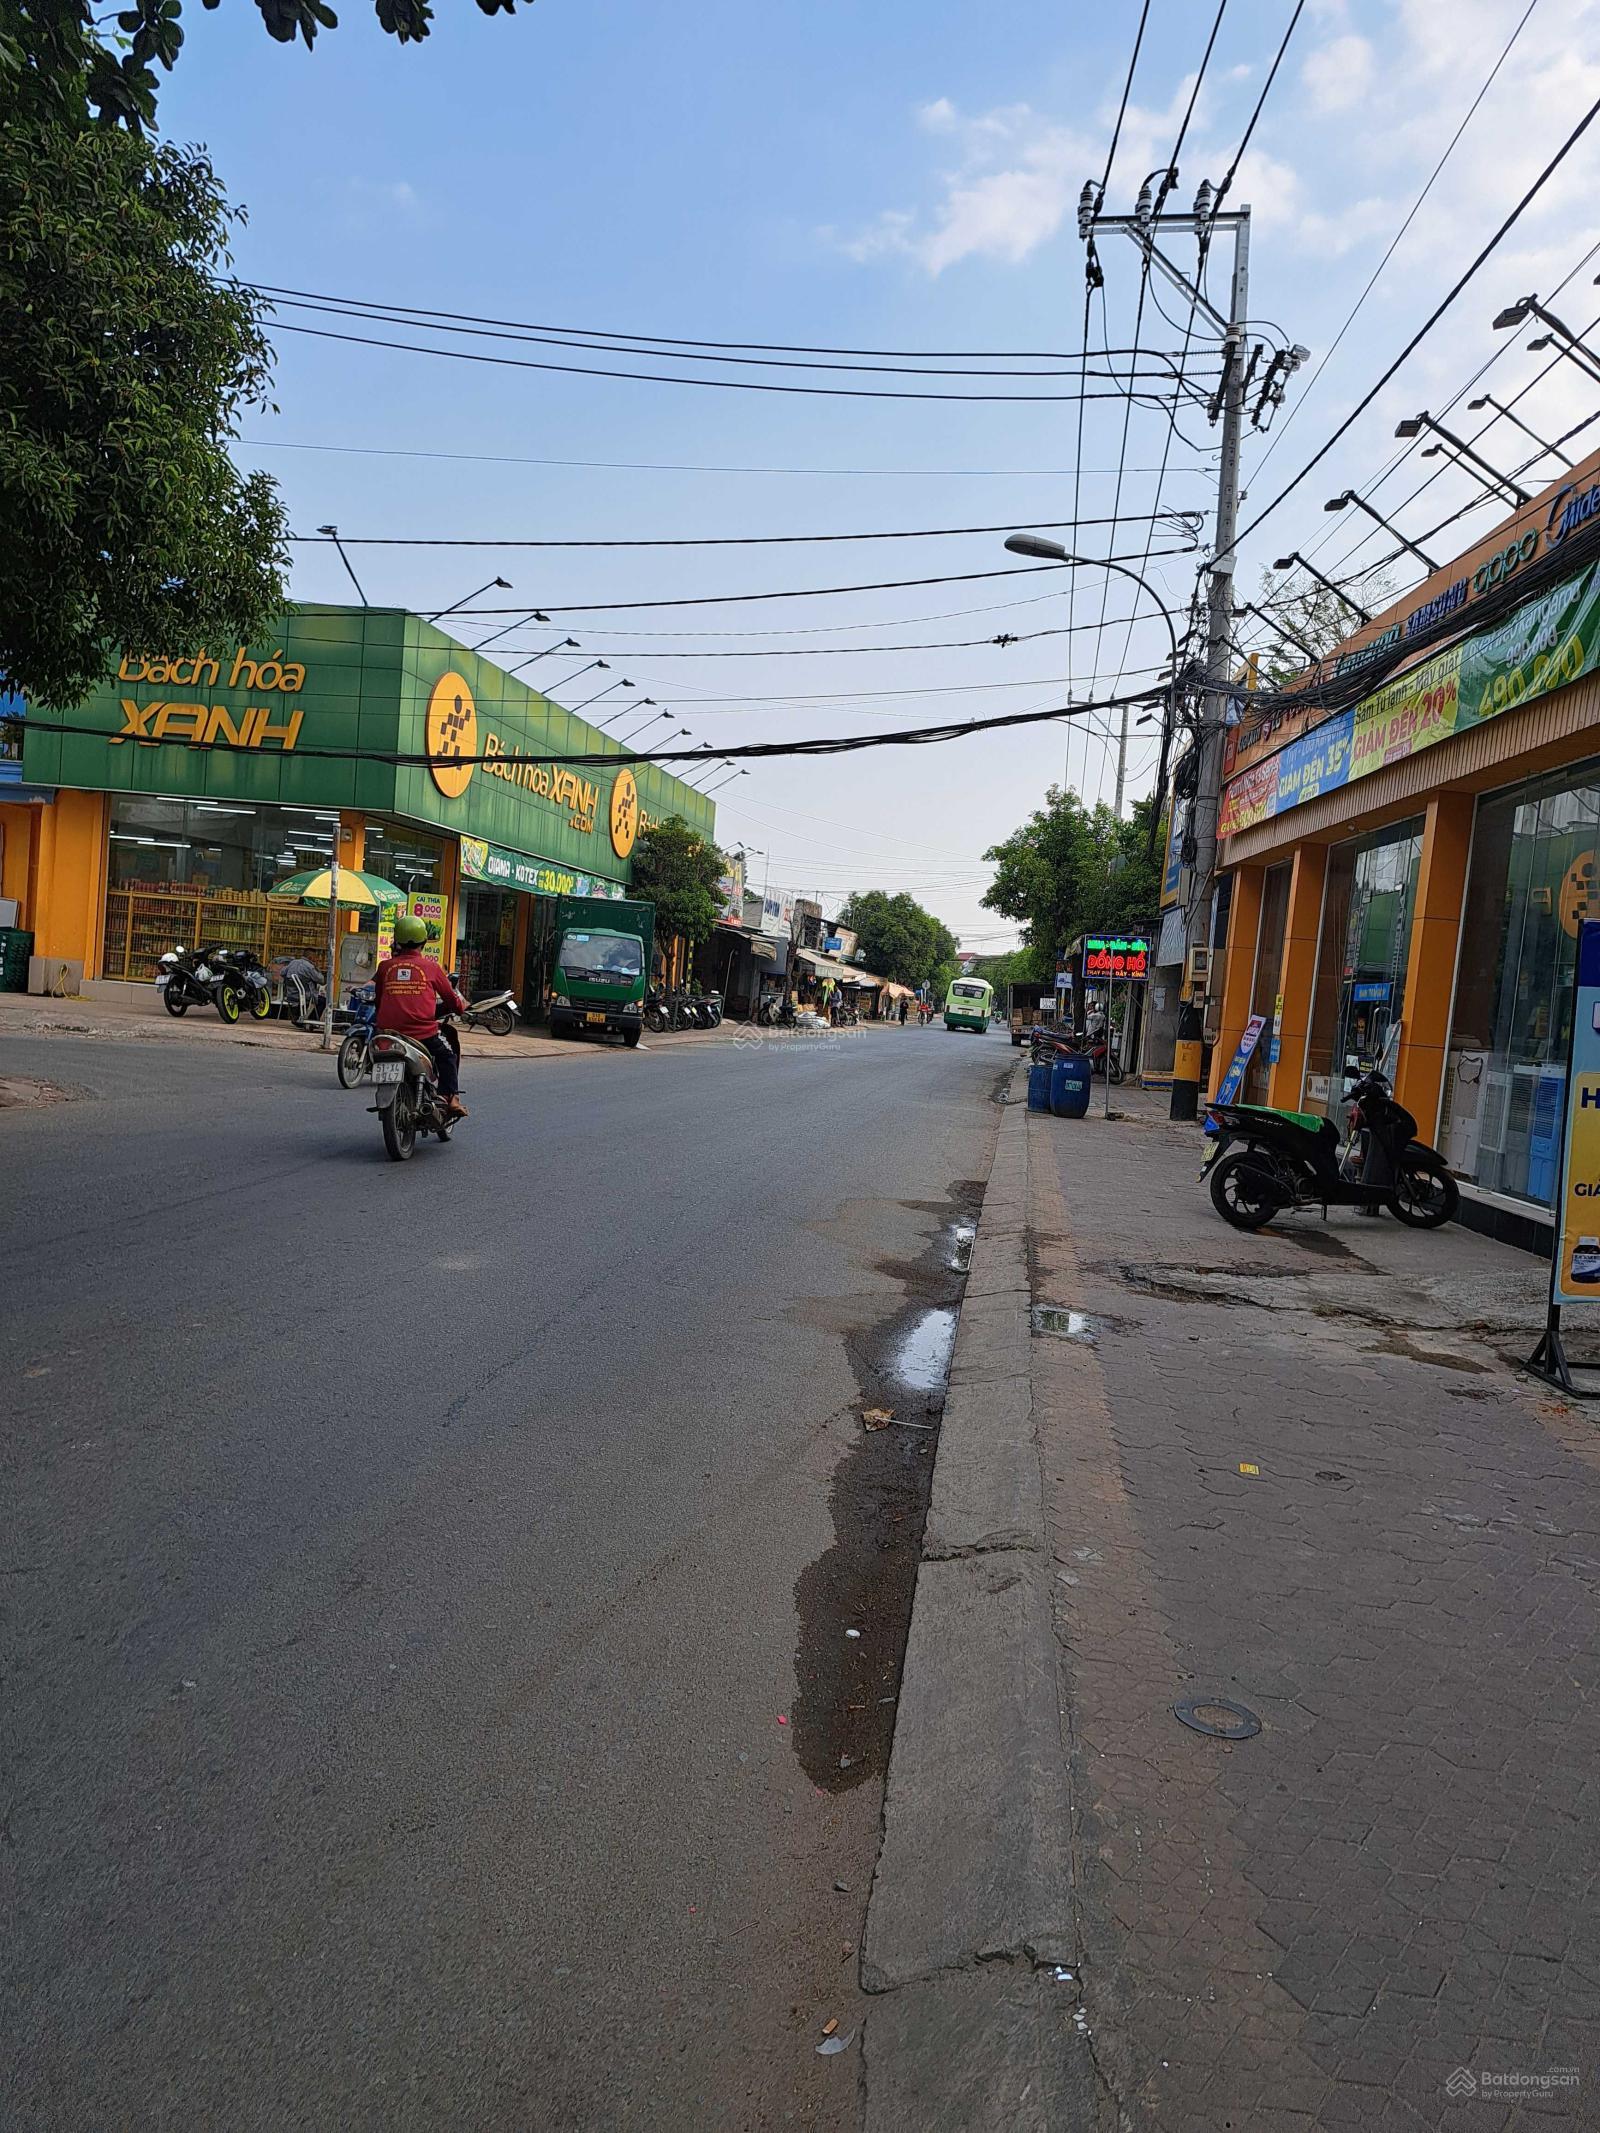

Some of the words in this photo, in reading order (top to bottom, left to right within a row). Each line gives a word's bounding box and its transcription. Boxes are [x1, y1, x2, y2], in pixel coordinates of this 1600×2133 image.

[229, 646, 306, 692] hóa
[109, 699, 305, 750] XANH
[1353, 720, 1387, 761] GIẢM
[1388, 699, 1419, 745] ĐẾN
[1420, 679, 1457, 731] 20%
[482, 732, 522, 786] Bách
[522, 751, 549, 797] hóa
[547, 763, 600, 819] XANH
[515, 863, 540, 886] KOTEX
